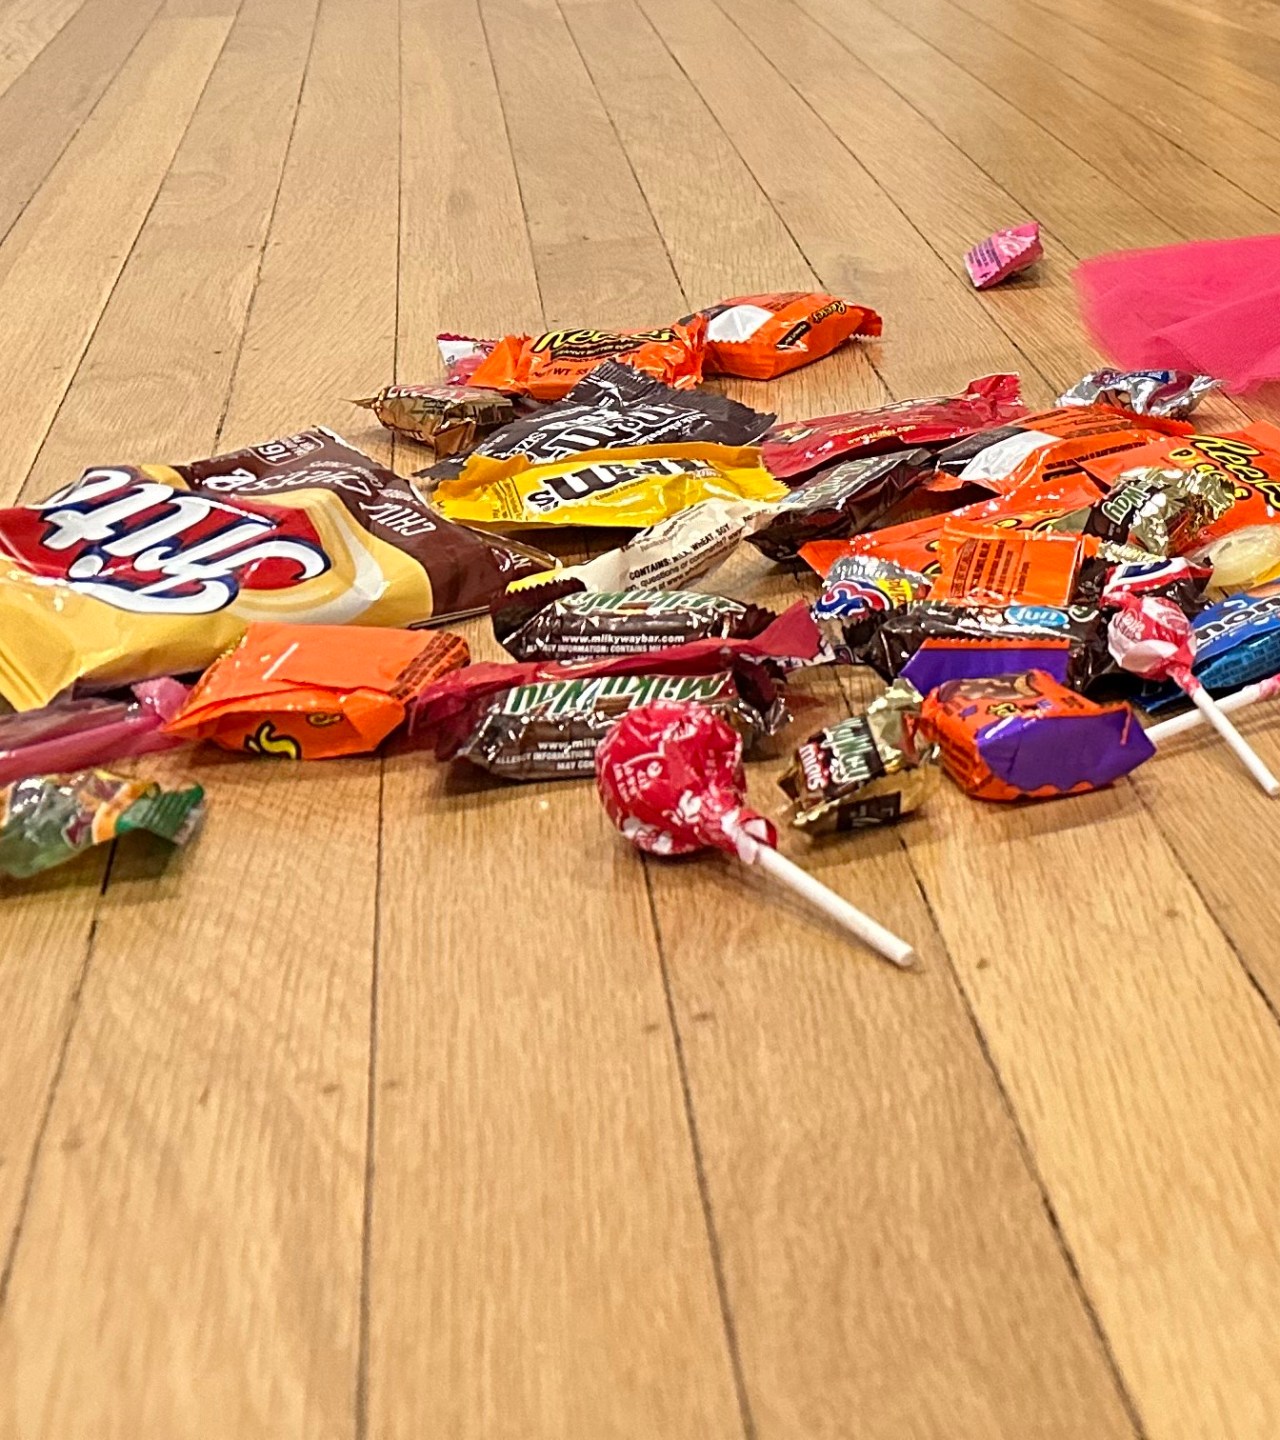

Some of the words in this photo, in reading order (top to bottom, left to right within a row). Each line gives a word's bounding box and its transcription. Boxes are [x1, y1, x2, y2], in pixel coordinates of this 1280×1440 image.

[257, 443, 292, 462] 16
[561, 632, 686, 645] www.milkywaybar.com
[799, 742, 831, 791] minis
